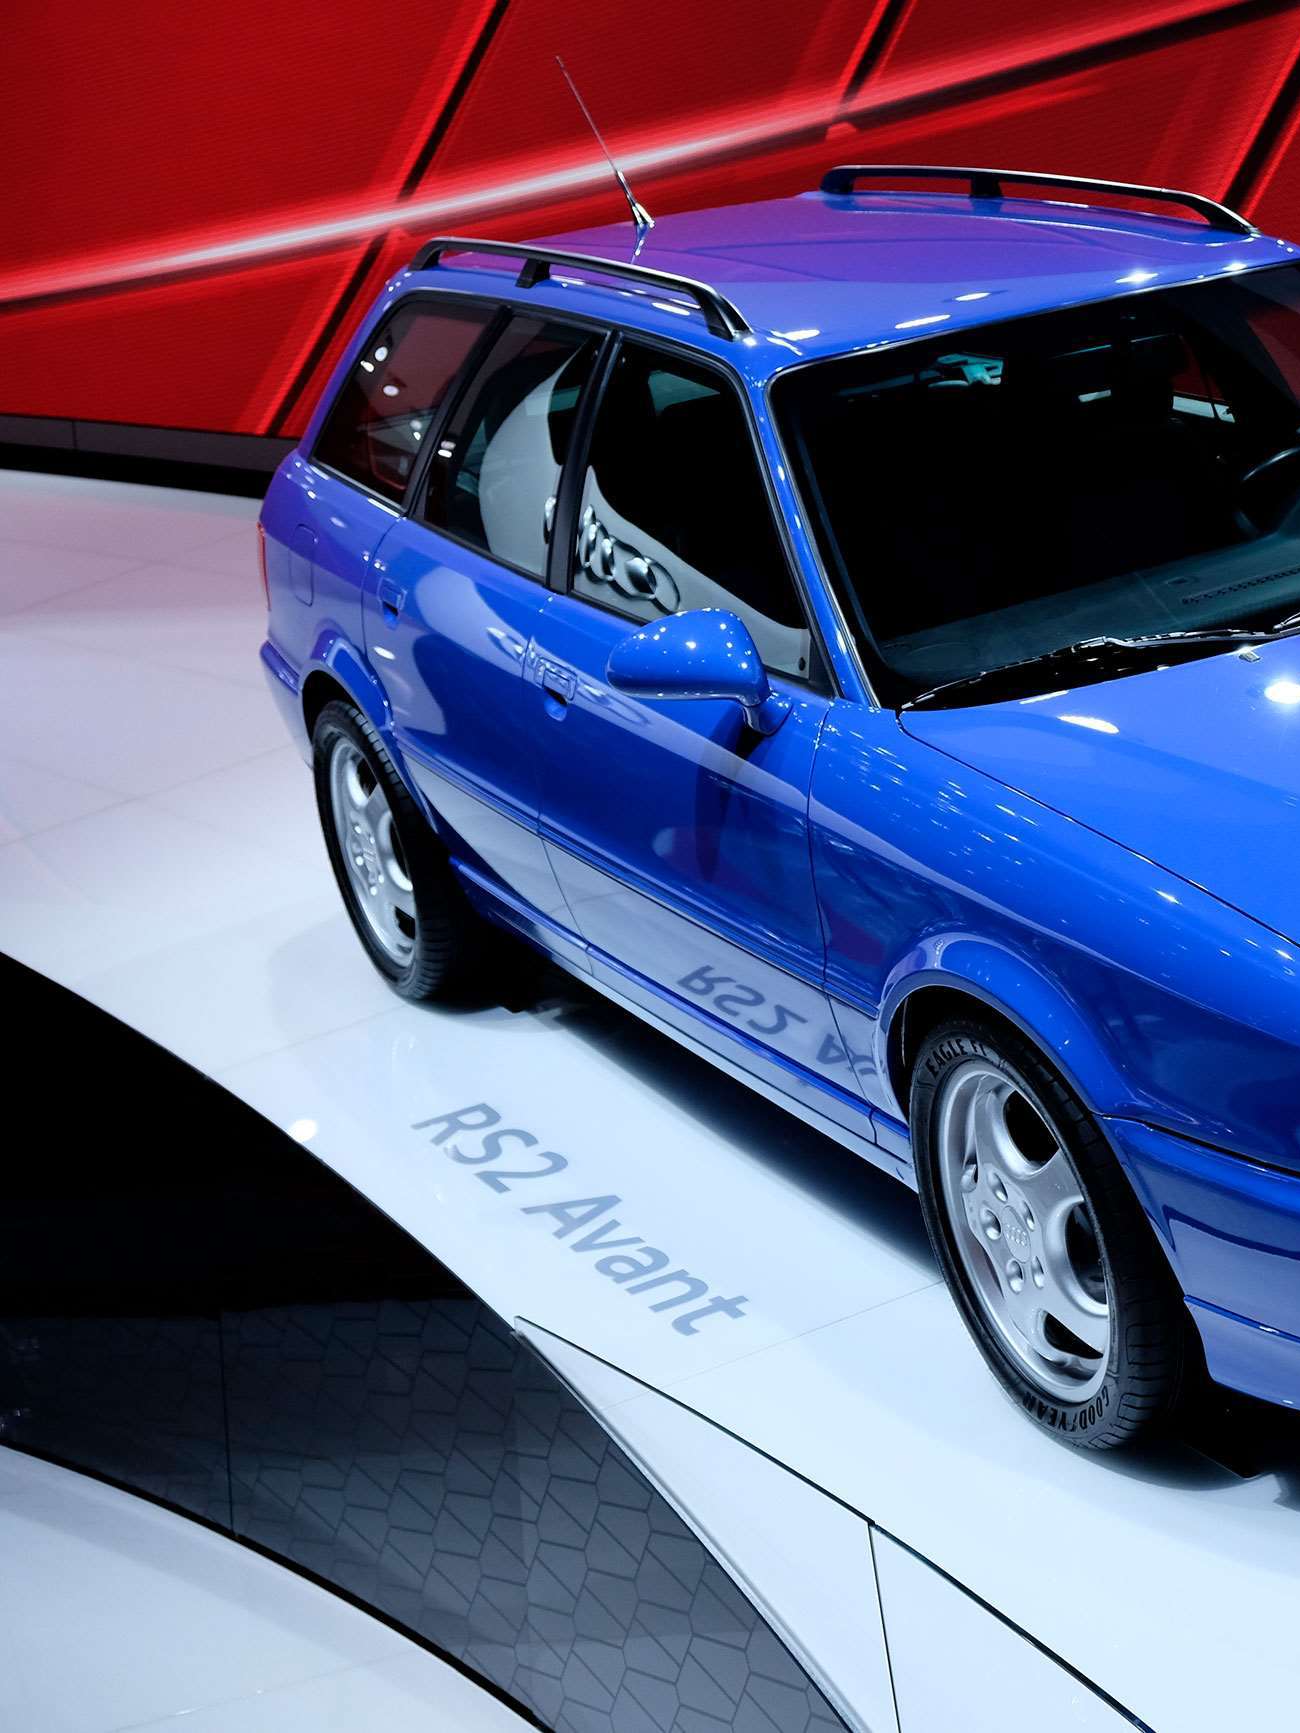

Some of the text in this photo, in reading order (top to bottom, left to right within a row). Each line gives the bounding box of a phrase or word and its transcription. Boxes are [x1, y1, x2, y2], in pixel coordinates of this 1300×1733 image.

[926, 1039, 968, 1078] EAGLE
[411, 1103, 749, 1336] RS2 Avant
